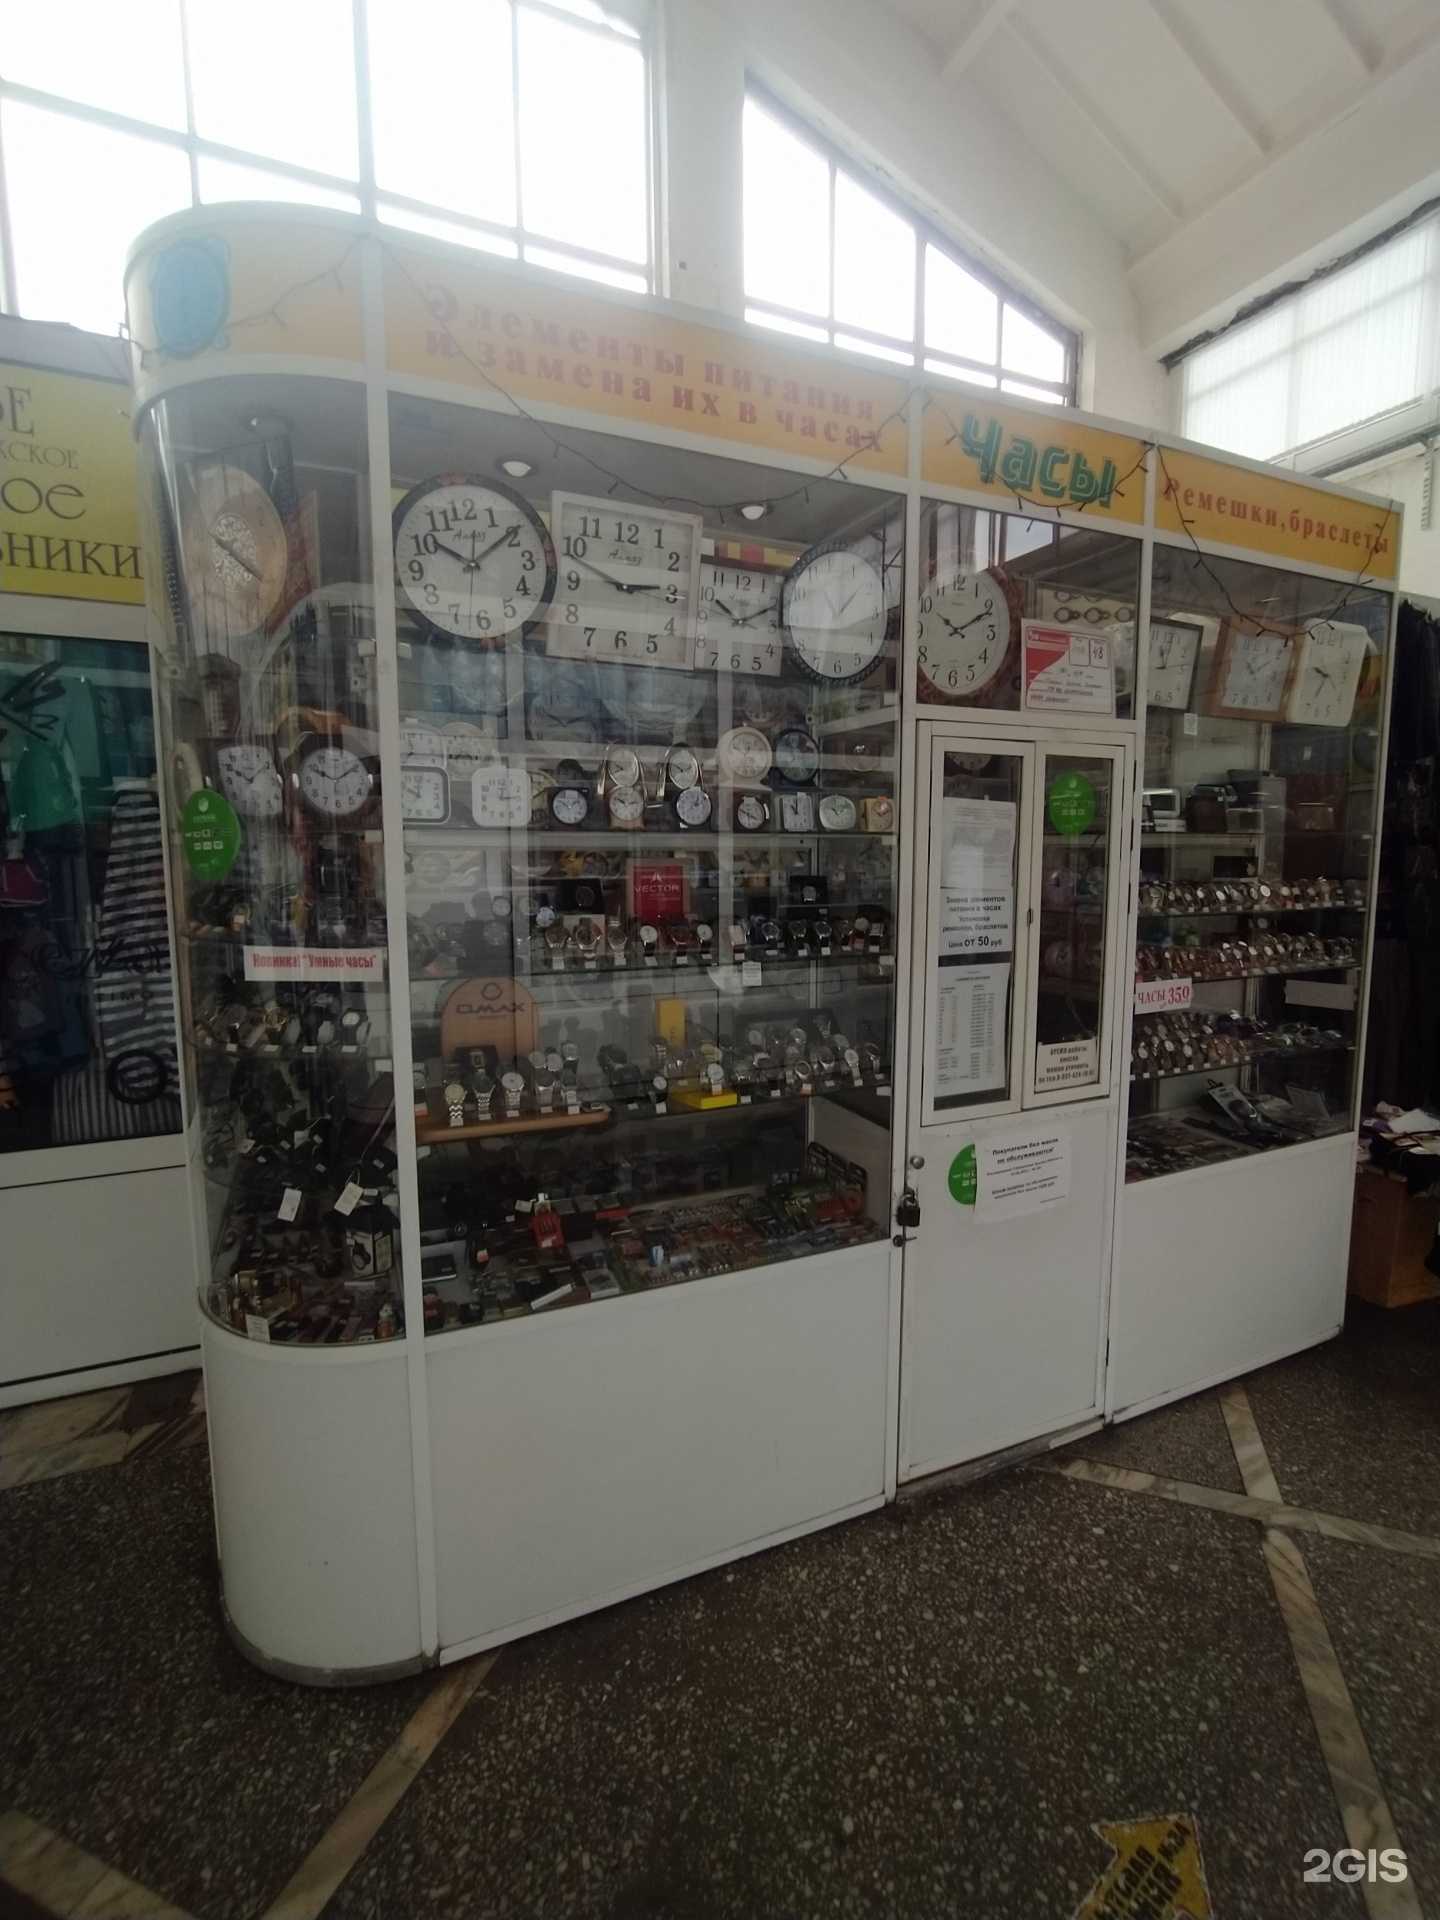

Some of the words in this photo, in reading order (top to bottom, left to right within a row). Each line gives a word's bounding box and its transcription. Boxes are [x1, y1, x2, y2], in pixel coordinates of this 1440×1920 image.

[425, 282, 684, 376] Элементы
[704, 360, 873, 420] питания
[477, 339, 651, 402] замена
[672, 385, 720, 416] их
[739, 401, 757, 424] в
[775, 407, 883, 452] часах
[0, 441, 79, 470] СКОЕ
[961, 414, 1118, 509] Часы
[451, 498, 478, 522] 12
[484, 507, 499, 528] 1
[425, 510, 454, 533] 11
[579, 516, 602, 539] 11
[614, 522, 640, 545] 12
[654, 528, 665, 549] 1
[411, 533, 438, 556] 10
[563, 536, 587, 558] 10
[0, 530, 144, 580] НИКИ
[521, 551, 535, 571] 3
[668, 551, 680, 572] 2
[408, 559, 425, 581] 9
[713, 571, 725, 587] 11
[516, 575, 531, 596] 4
[567, 570, 580, 591] 9
[736, 576, 751, 591] 12
[761, 578, 766, 593] 1
[423, 583, 440, 605] 8
[665, 584, 678, 604] 3
[701, 586, 715, 602] 10
[449, 604, 460, 624] 7
[503, 598, 517, 618] 5
[566, 604, 579, 624] 8
[920, 596, 932, 613] 10
[476, 610, 491, 630] 6
[697, 609, 708, 624] 9
[768, 619, 777, 634] 3
[583, 627, 597, 647] 7
[664, 617, 675, 637] 4
[986, 625, 996, 641] 3
[614, 631, 627, 649] 6
[646, 634, 658, 654] 5
[766, 642, 774, 658] 4
[710, 651, 719, 667] 7
[731, 655, 741, 669] 6
[752, 657, 762, 671] 5
[918, 646, 928, 664] 8
[978, 648, 988, 664] 4
[833, 660, 842, 673] 6
[931, 664, 940, 680] 7
[966, 664, 975, 681] 5
[948, 670, 958, 687] 6
[635, 884, 681, 894] VECTOR
[977, 935, 990, 947] 50
